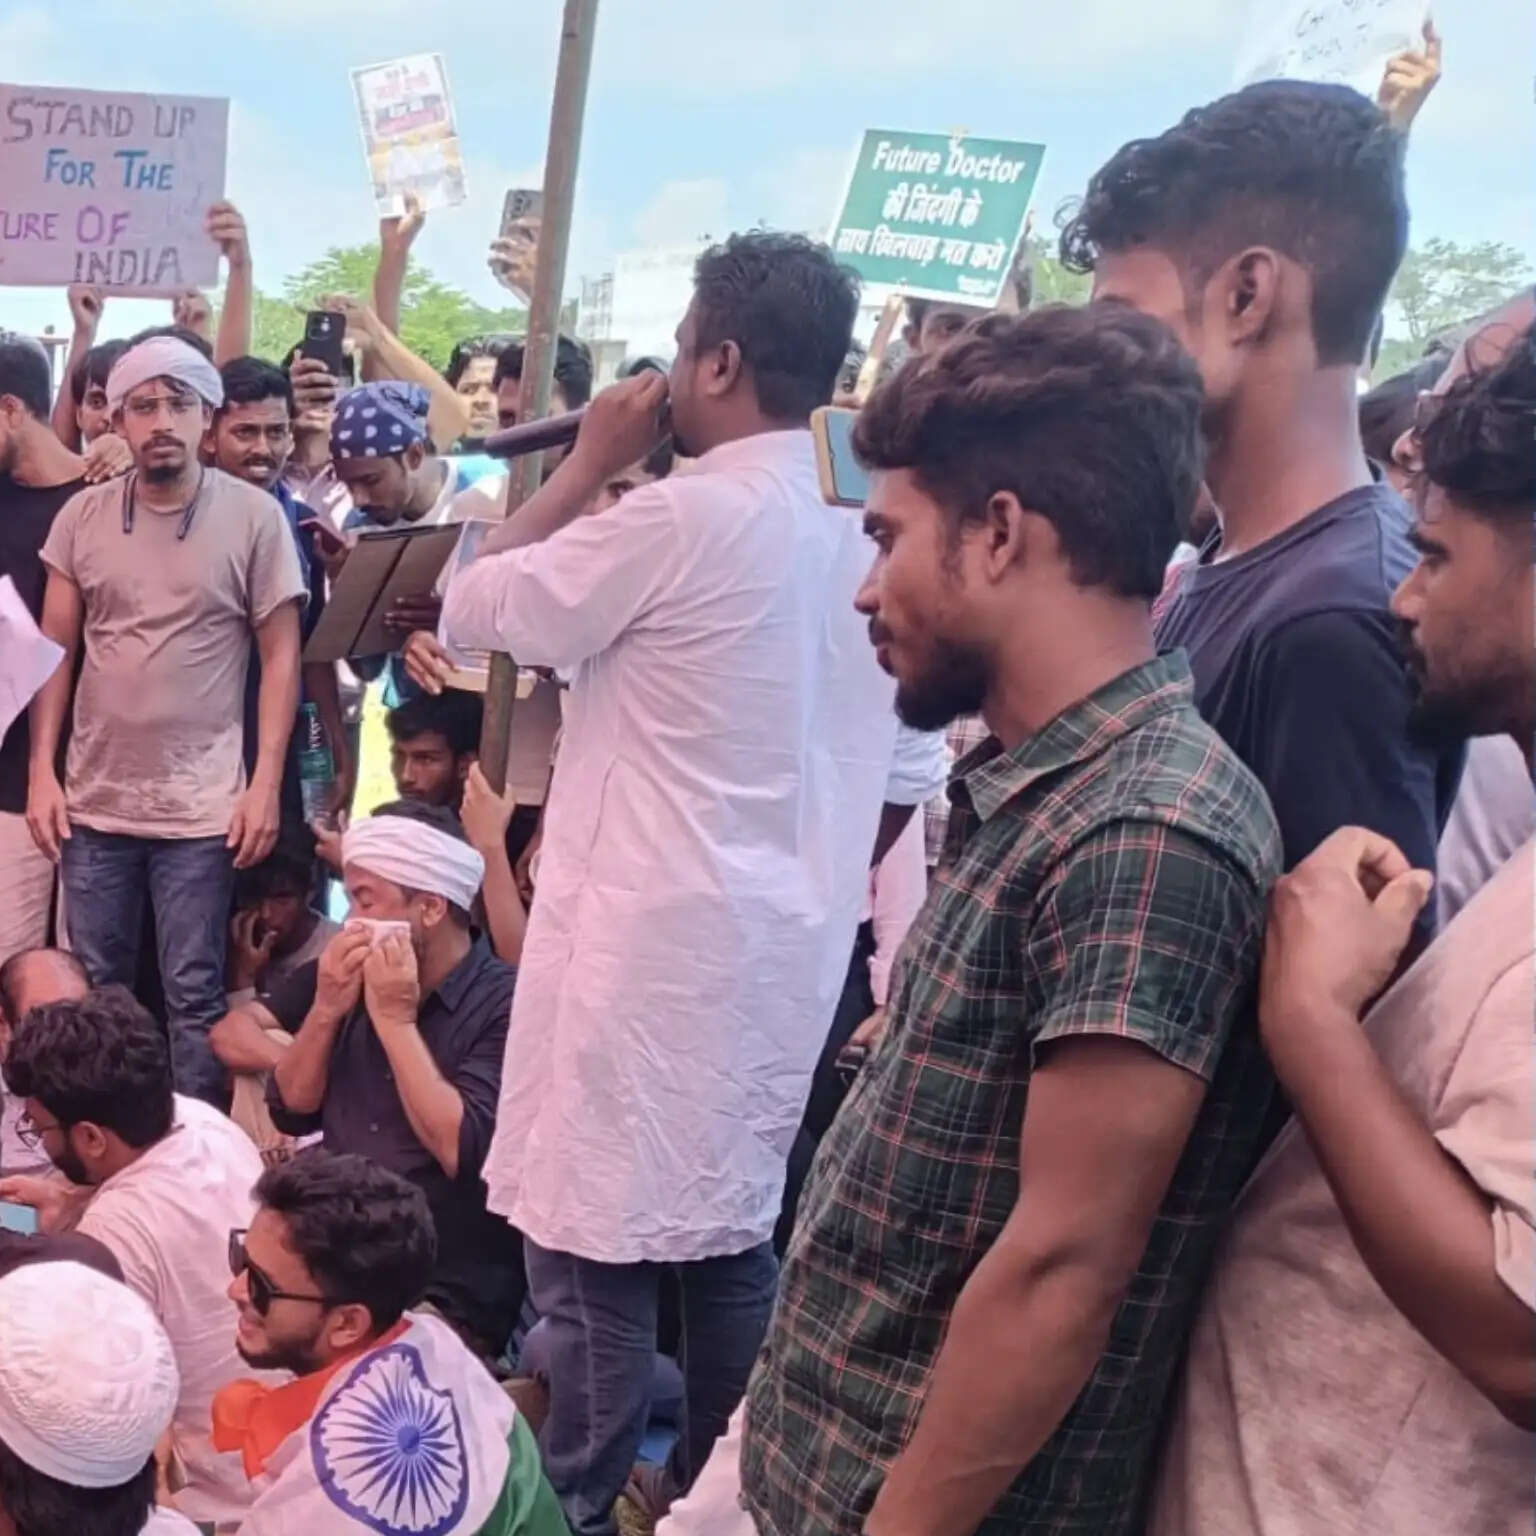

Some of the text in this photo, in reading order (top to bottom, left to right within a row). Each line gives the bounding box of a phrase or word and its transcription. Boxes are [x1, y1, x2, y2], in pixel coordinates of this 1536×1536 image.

[2, 96, 195, 143] STAND UP
[873, 141, 1026, 183] Future Doctor
[76, 206, 130, 246] OF
[882, 182, 983, 228] की जिंदगी के
[73, 247, 183, 286] INDIA
